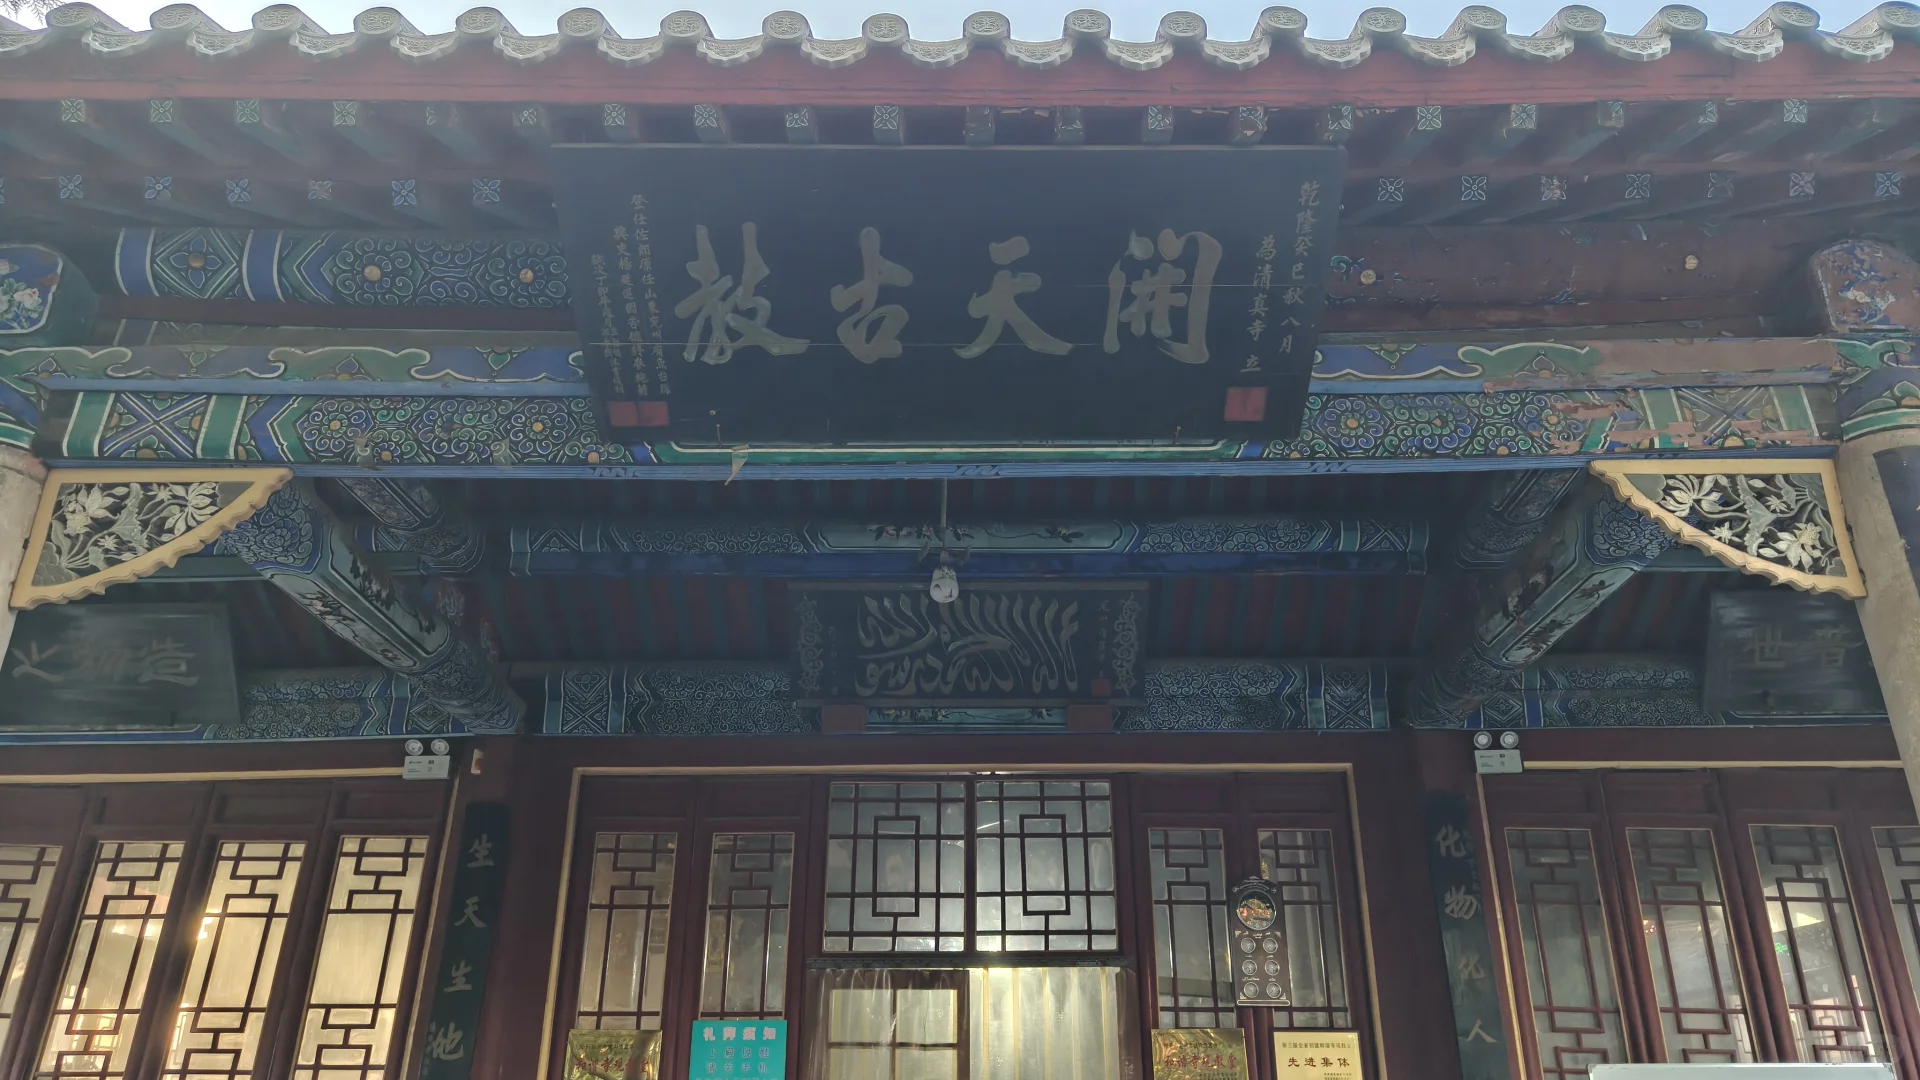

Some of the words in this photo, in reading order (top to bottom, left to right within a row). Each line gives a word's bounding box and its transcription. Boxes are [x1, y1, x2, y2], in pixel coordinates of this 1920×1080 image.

[1279, 181, 1321, 355] 乾隆癸巳秋八月
[1287, 1056, 1350, 1068] 先进集体
